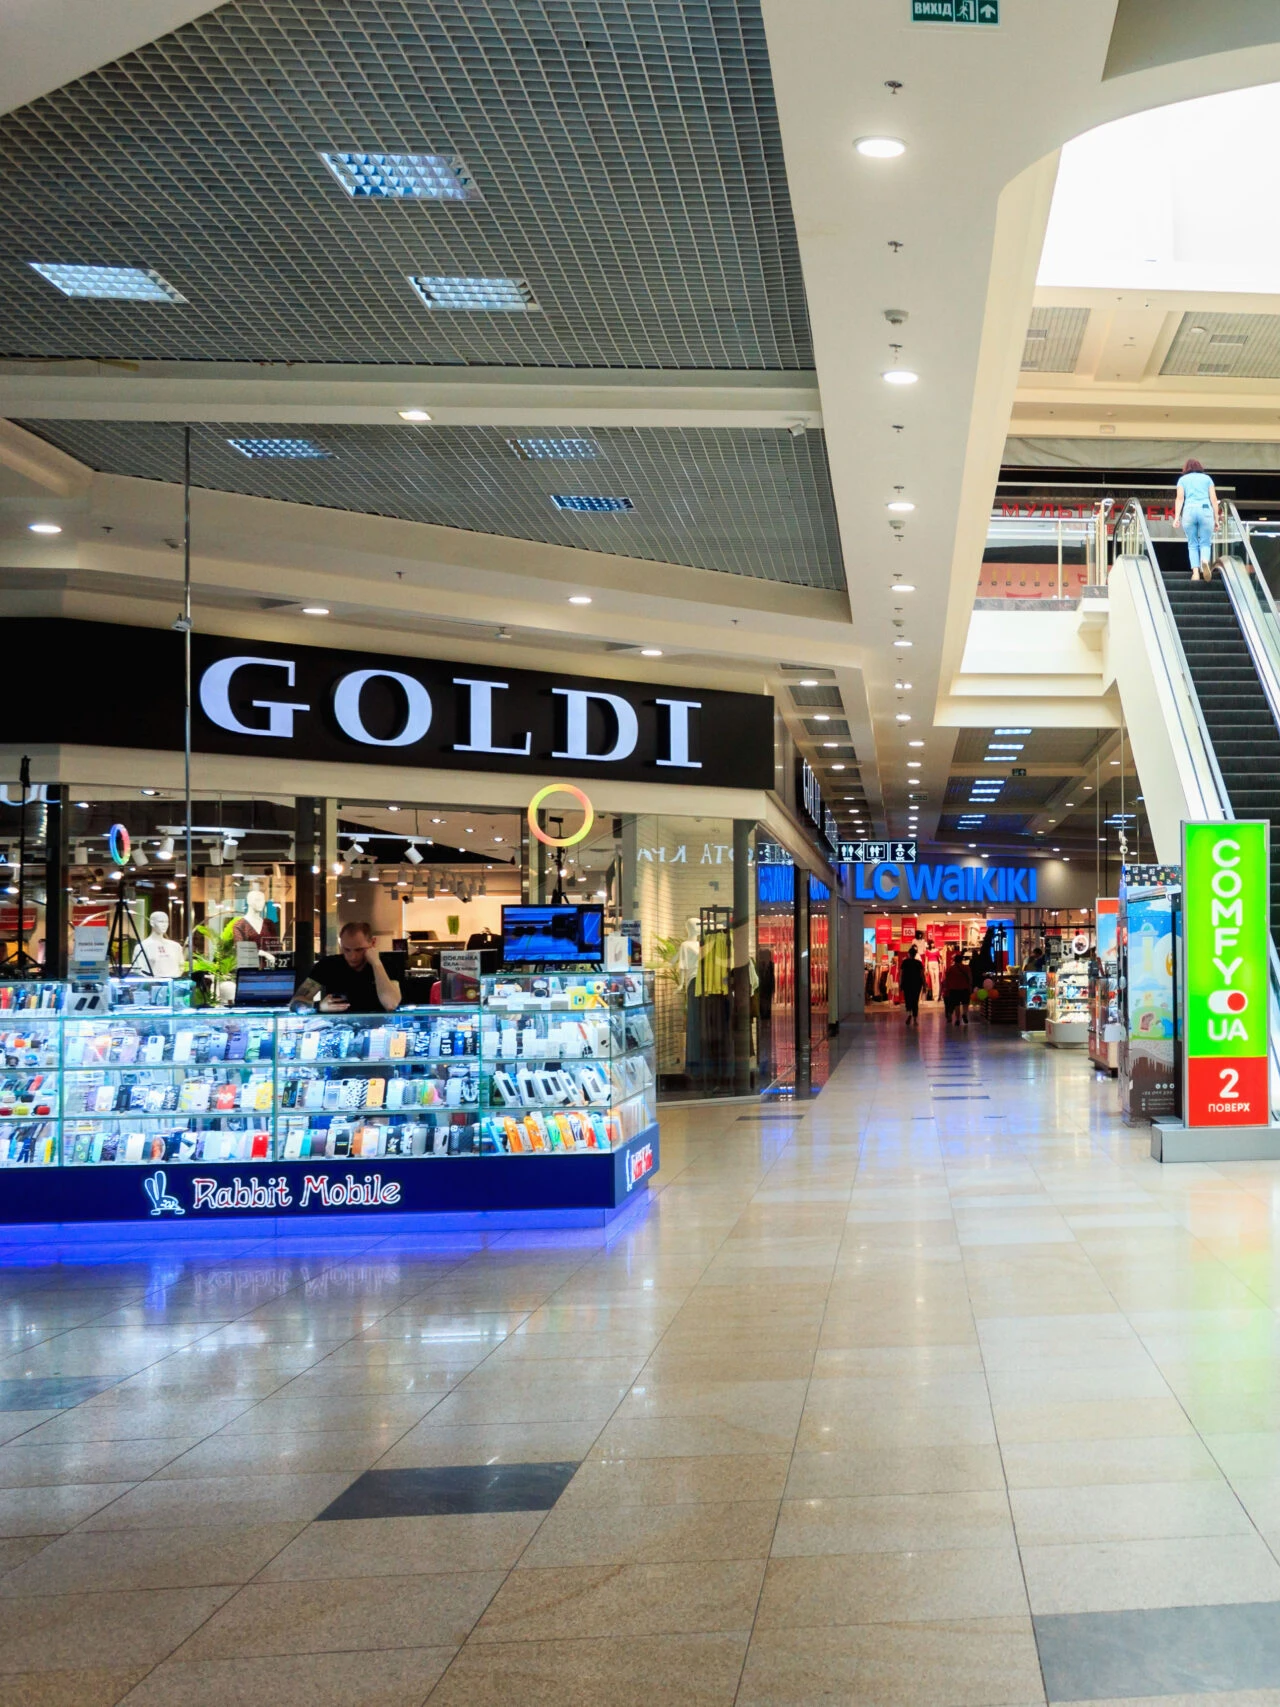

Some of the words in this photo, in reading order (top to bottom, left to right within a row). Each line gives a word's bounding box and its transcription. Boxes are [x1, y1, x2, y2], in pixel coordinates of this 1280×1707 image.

[914, 2, 952, 16] ВИХІД
[199, 655, 703, 768] GOLDI
[855, 863, 901, 900] LC
[1211, 839, 1243, 985] COMFY
[1208, 1019, 1248, 1041] UA
[1219, 1068, 1240, 1098] 2
[1208, 1103, 1250, 1112] ПОВЕРХ
[193, 1177, 292, 1209] Rabbit
[300, 1174, 401, 1207] Mobile
